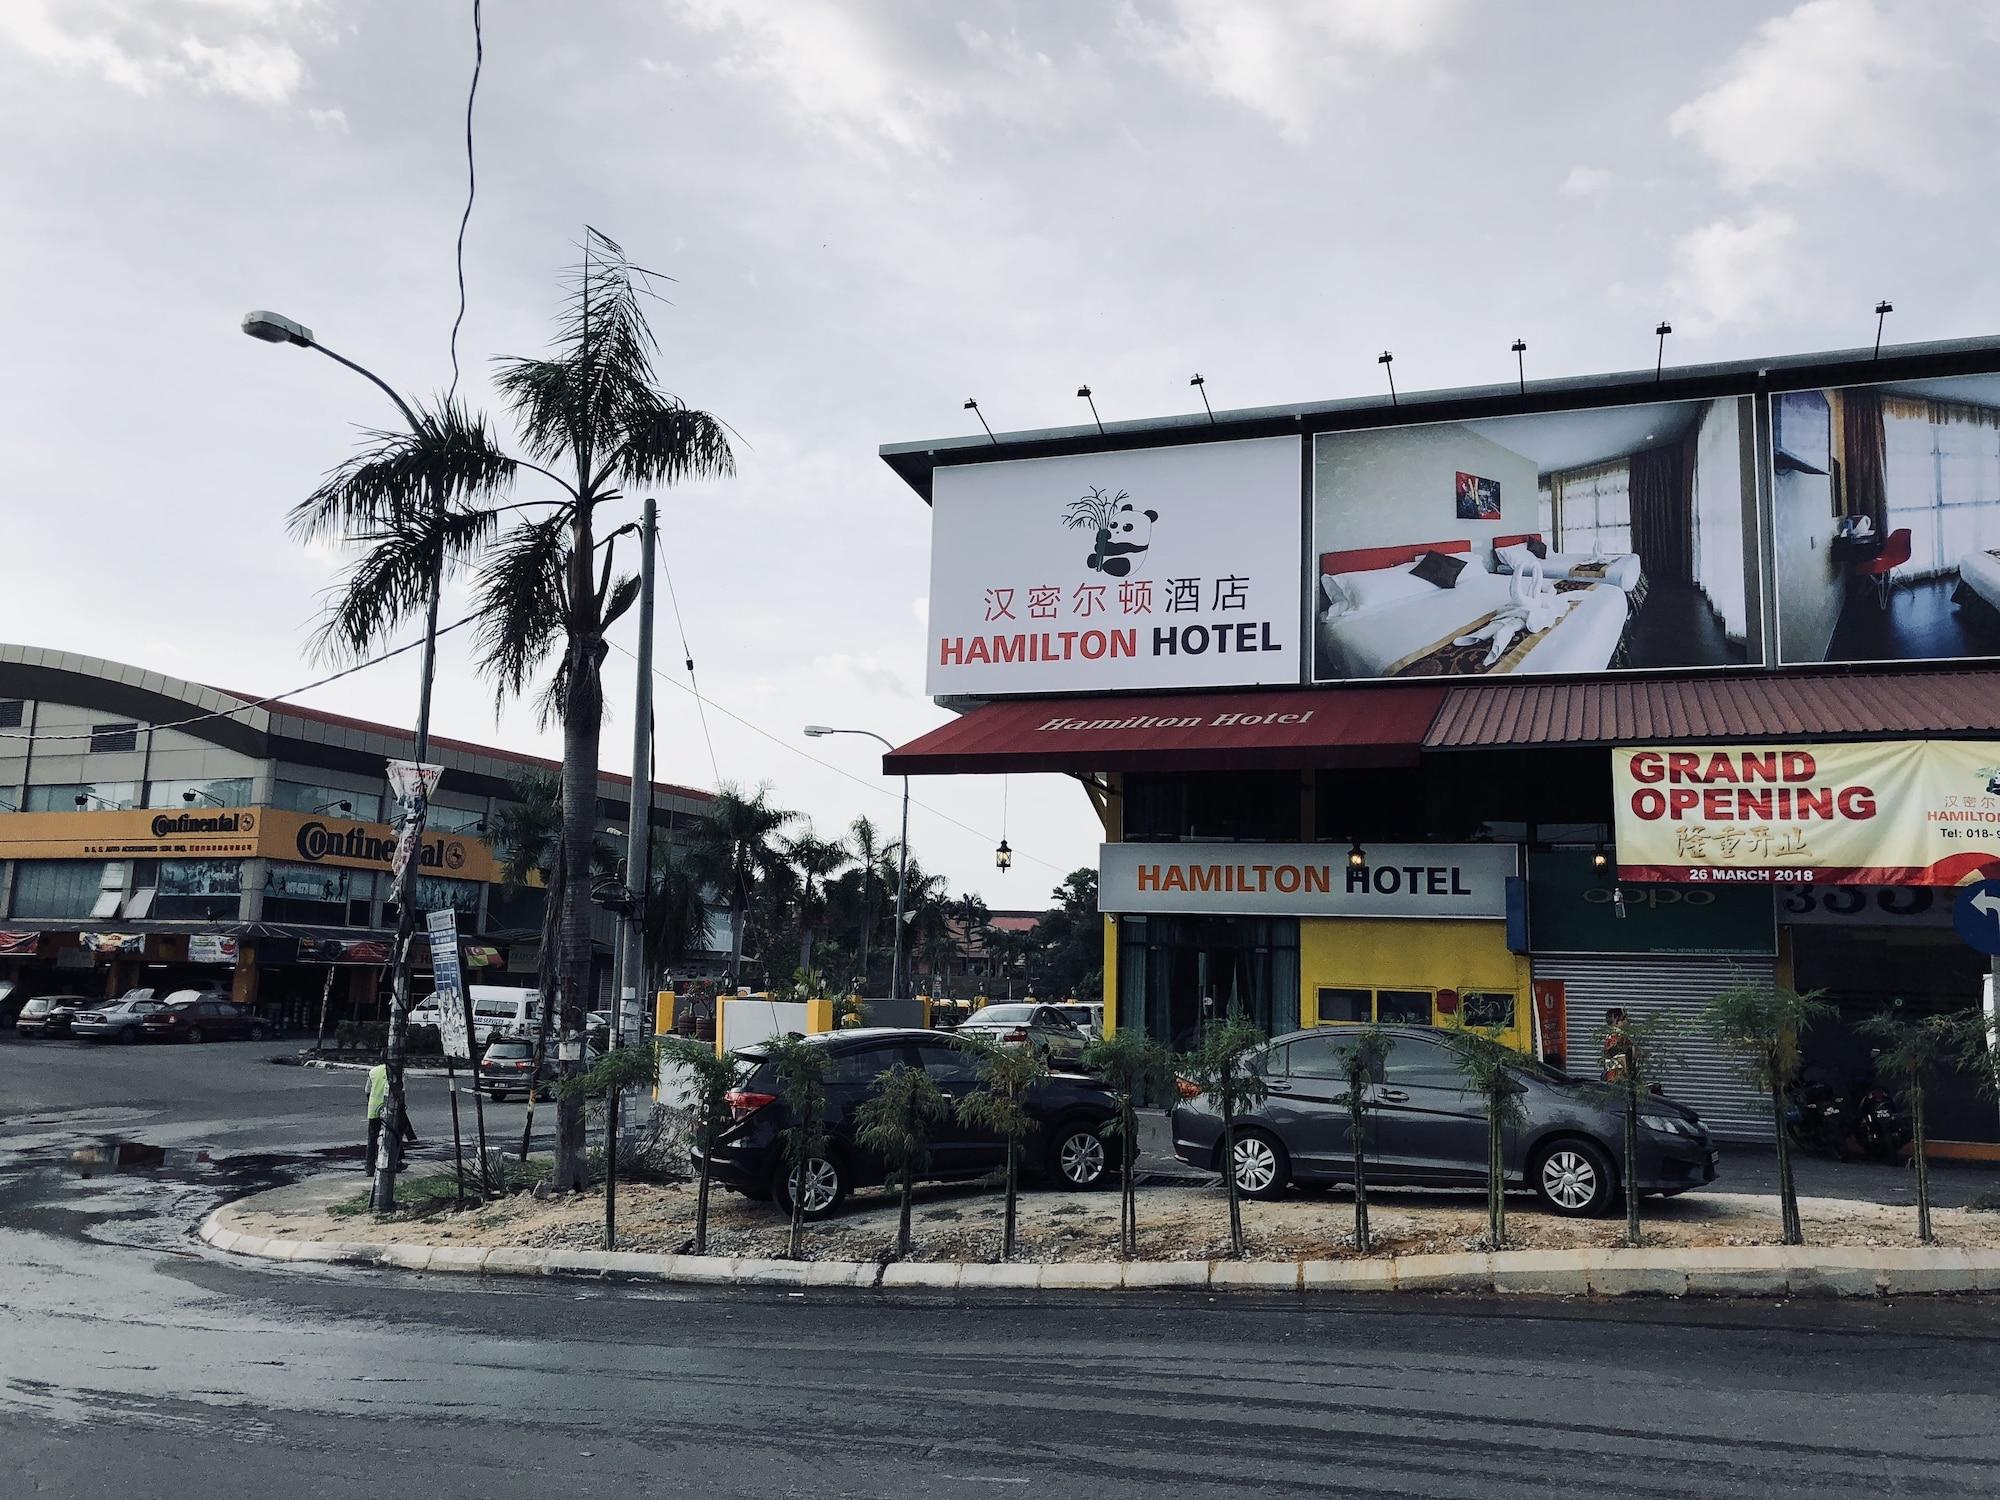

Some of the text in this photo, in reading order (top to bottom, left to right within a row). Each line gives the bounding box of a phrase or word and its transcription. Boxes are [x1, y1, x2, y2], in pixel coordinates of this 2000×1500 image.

[984, 574, 1250, 622] 汉密尔顿酒店
[940, 622, 1282, 666] HAMILTON HOTEL
[1035, 710, 1314, 732] Hamilton Hotel
[1629, 751, 1816, 784] GRAND
[1631, 786, 1877, 821] OPENING
[1927, 811, 2000, 823] HAMILTO
[152, 812, 240, 838] Continental
[1940, 828, 1962, 838] Tel:
[296, 821, 445, 867] Contineal
[1676, 825, 1812, 859] 隆重开业
[1138, 864, 1472, 896] HAMILTON HOTEL
[1689, 869, 1813, 881] 26 MARCH 2018
